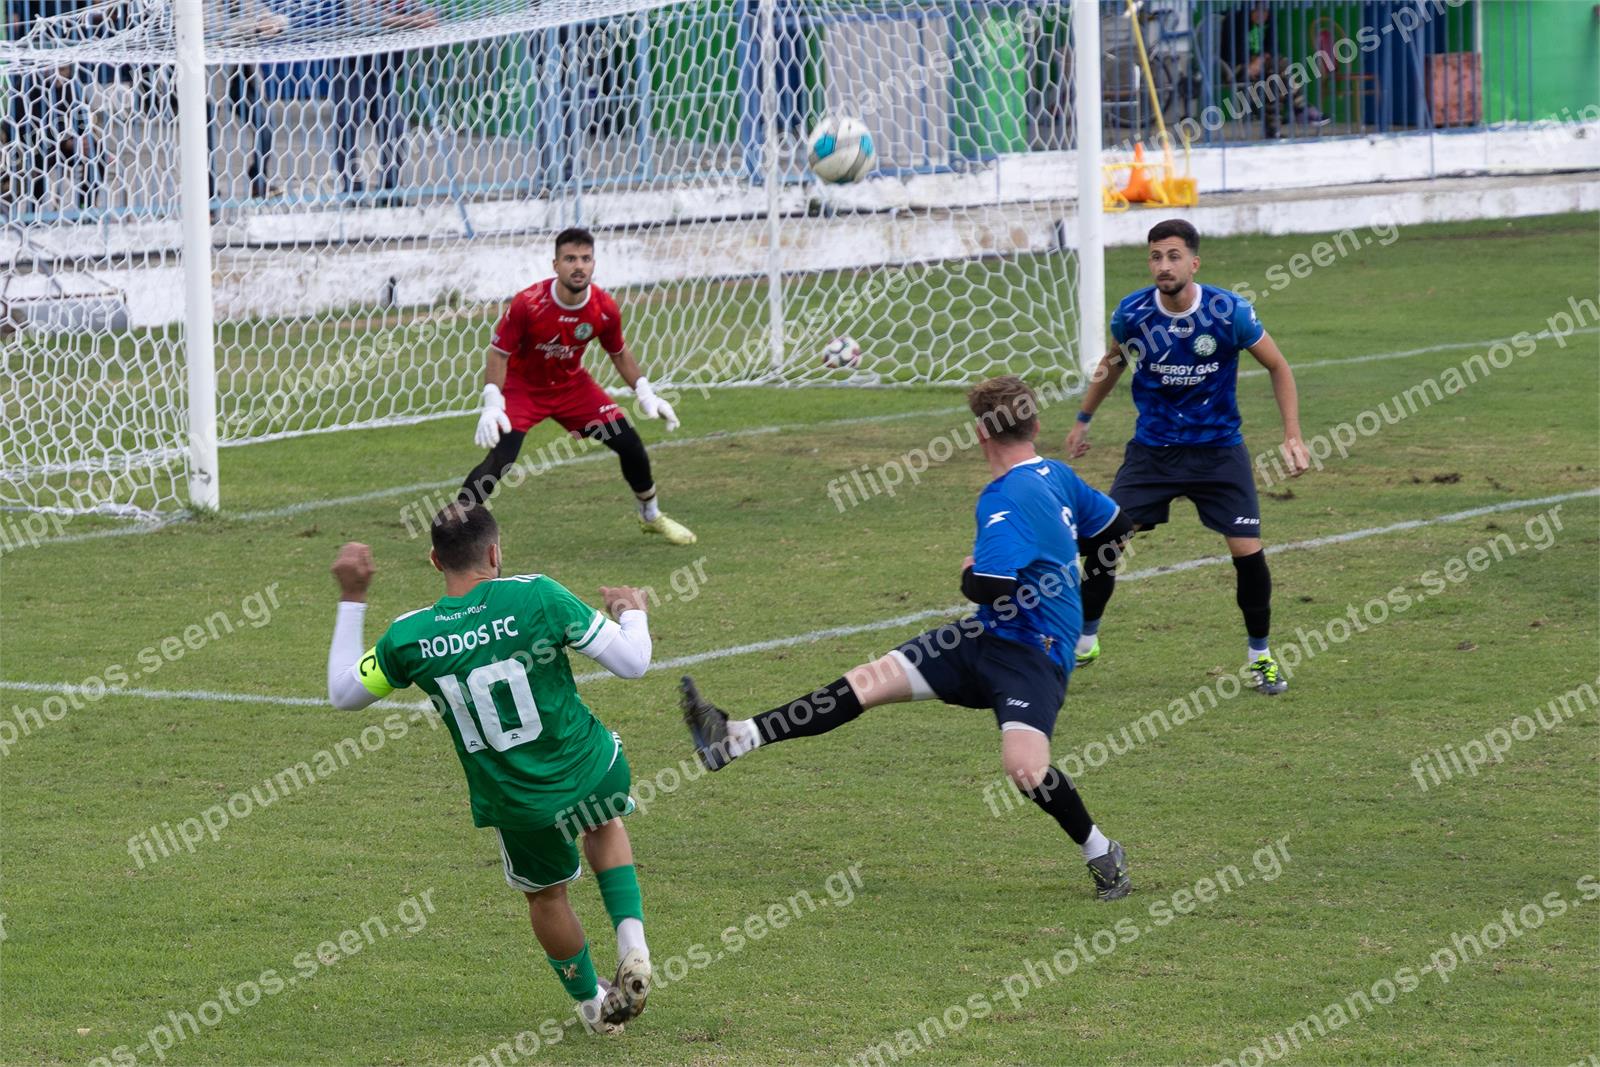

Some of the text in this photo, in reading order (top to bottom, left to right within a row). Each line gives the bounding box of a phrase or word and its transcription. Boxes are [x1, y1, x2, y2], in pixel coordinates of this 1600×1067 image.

[1150, 362, 1219, 375] ENERGY GAS
[1234, 516, 1261, 525] Zeus
[418, 616, 520, 659] RODOS FC
[434, 658, 544, 754] 10
